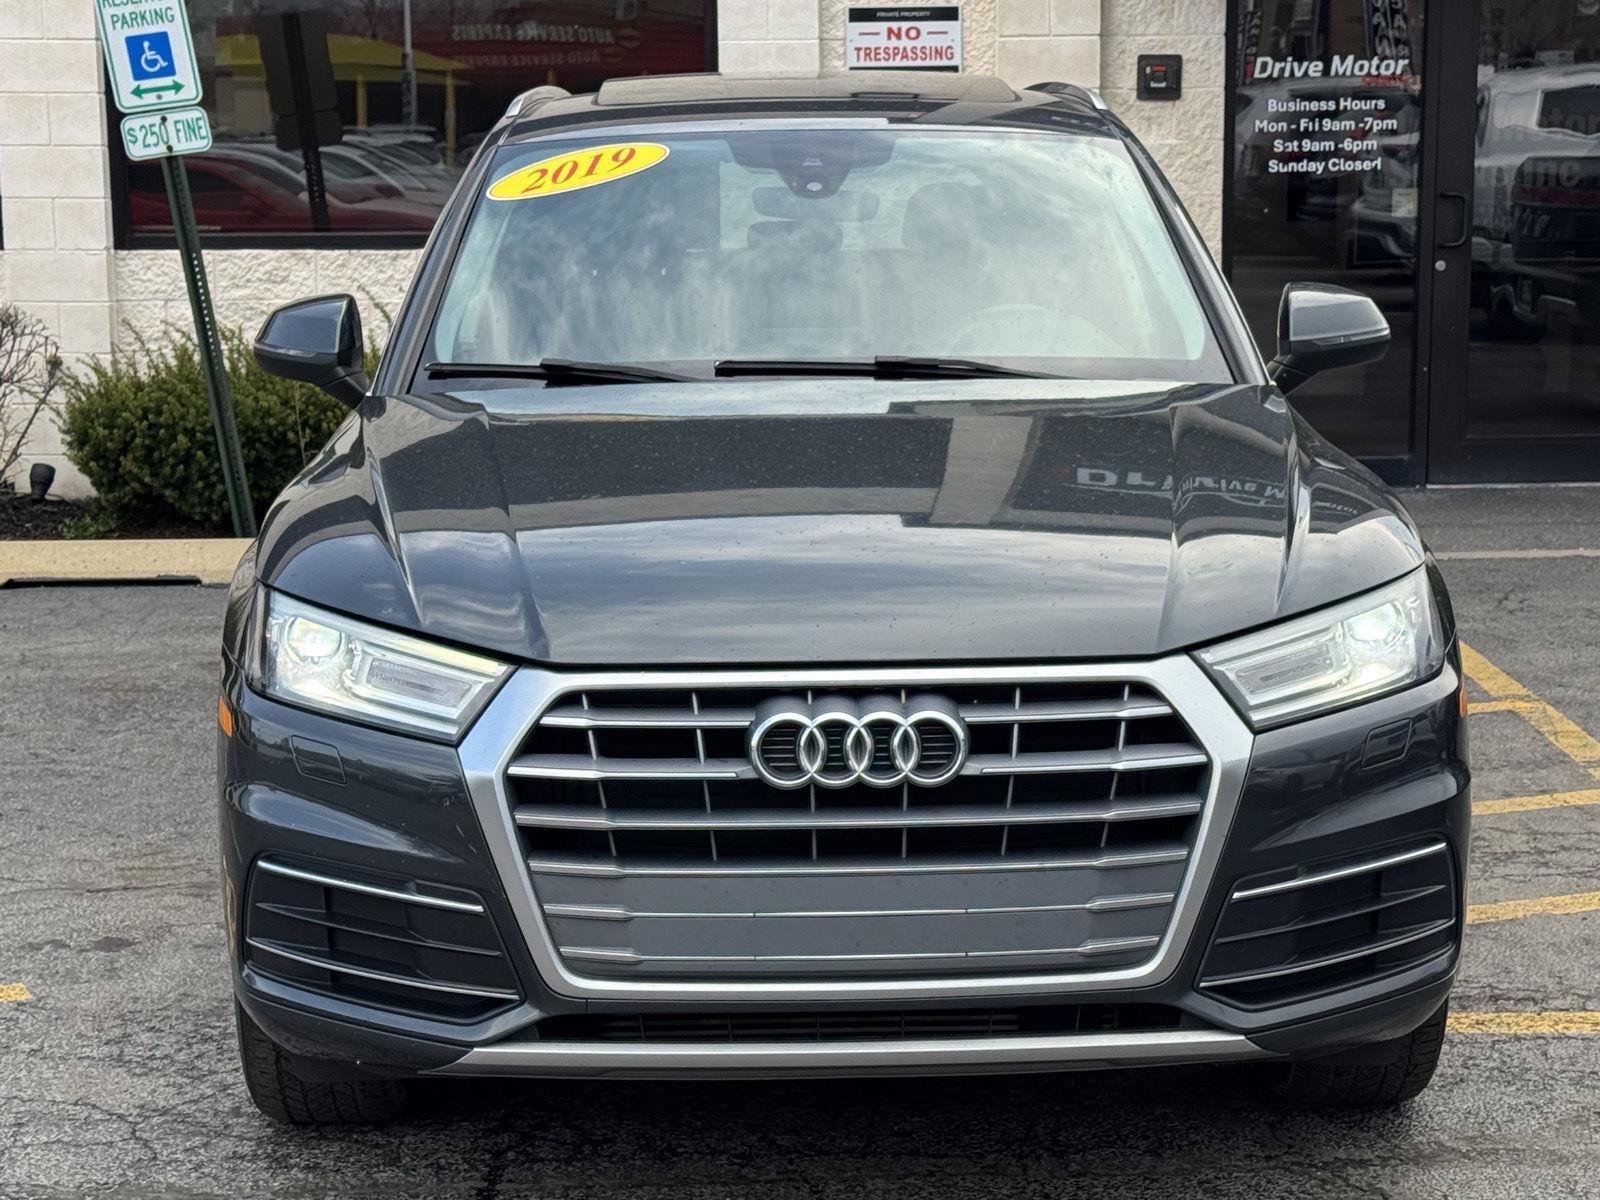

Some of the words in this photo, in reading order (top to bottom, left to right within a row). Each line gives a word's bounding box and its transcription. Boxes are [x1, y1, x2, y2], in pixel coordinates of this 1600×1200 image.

[110, 6, 175, 31] PARKING
[886, 26, 921, 41] NO
[854, 45, 955, 62] TRESPASSING
[1330, 54, 1410, 77] Motor
[1267, 98, 1336, 113] Business
[1340, 97, 1386, 111] Hours
[126, 120, 170, 148] $250
[173, 117, 208, 144] FINE
[1254, 120, 1288, 133] Mon
[1322, 118, 1356, 131] 9am
[1273, 139, 1302, 153] Sat
[1302, 139, 1336, 153] 9am
[521, 147, 637, 194] 2019
[1268, 159, 1327, 175] Sunday
[1328, 157, 1382, 173] Closed
